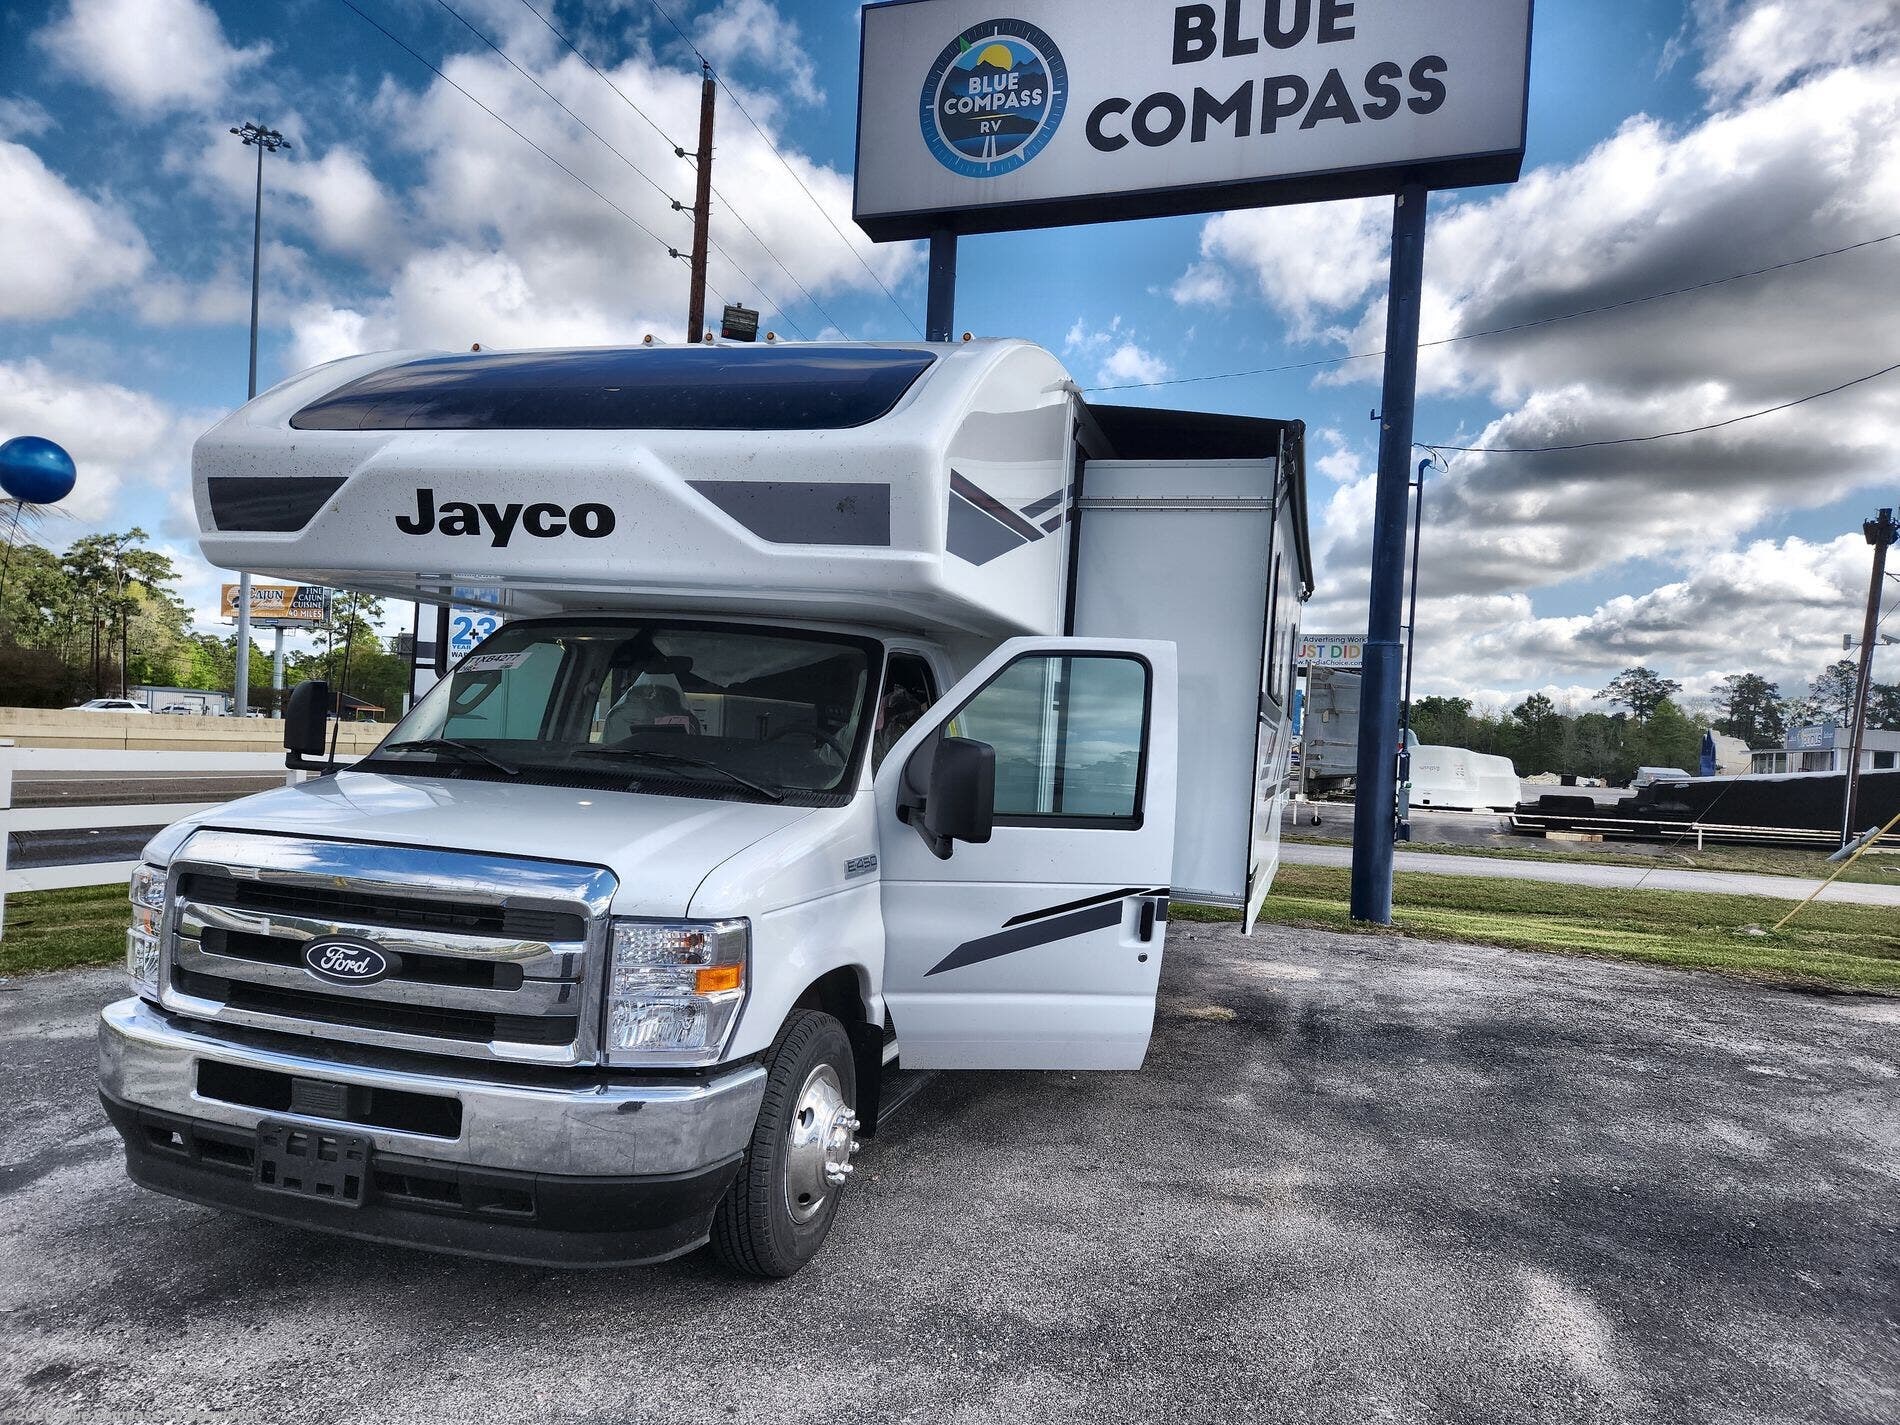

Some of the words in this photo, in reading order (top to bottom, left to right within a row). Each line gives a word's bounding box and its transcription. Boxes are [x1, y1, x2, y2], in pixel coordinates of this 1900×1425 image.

[1172, 0, 1355, 65] BLUE
[968, 72, 1019, 94] BLUE
[944, 88, 1043, 115] COMPASS
[1085, 55, 1449, 152] COMPASS
[980, 120, 1002, 134] RV
[395, 488, 616, 548] Jayco
[298, 594, 323, 602] CAJUN
[306, 587, 323, 595] FINE
[292, 601, 323, 609] CUISINE
[300, 609, 323, 618] MILES
[1297, 645, 1326, 658] UST
[1331, 645, 1360, 658] DID
[320, 946, 371, 974] Ford
